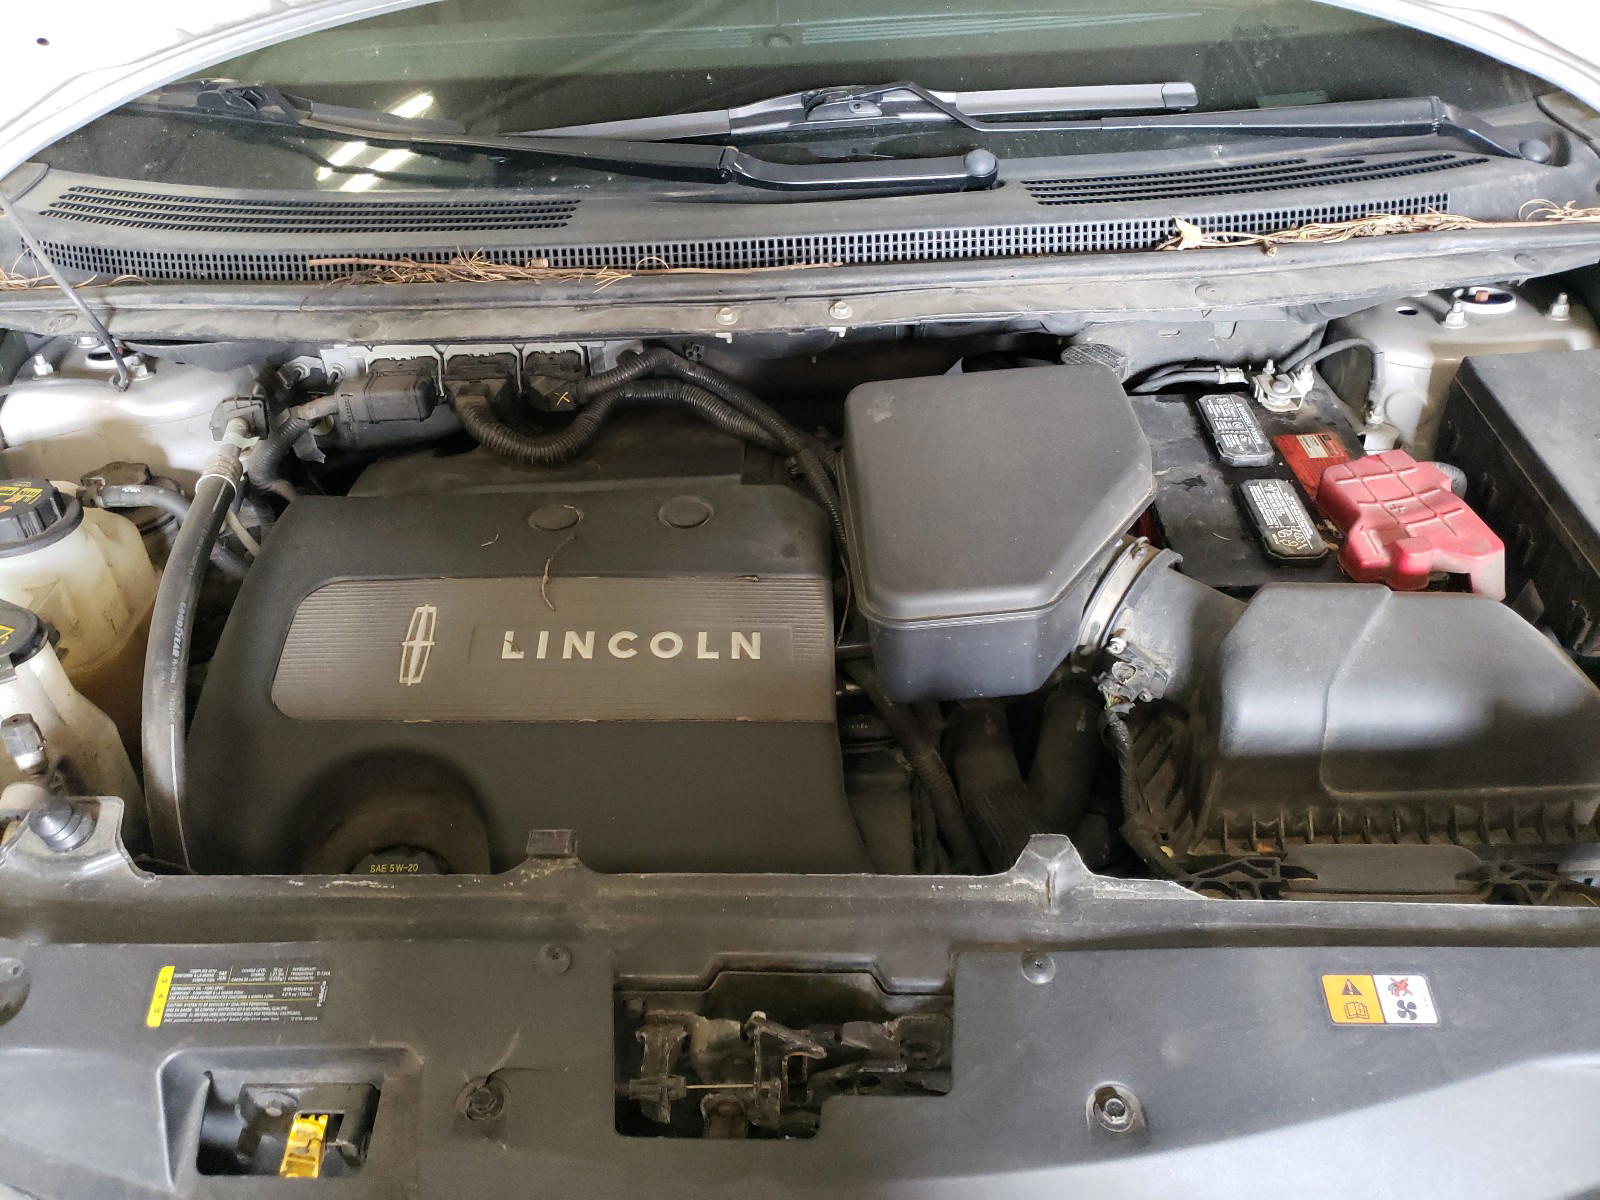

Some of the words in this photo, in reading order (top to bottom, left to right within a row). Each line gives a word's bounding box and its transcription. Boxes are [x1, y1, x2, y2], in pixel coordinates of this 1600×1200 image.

[172, 602, 186, 657] GOODYEAR
[501, 630, 761, 660] LINCOLN
[370, 864, 387, 873] SAE
[389, 863, 419, 873] 5W-20
